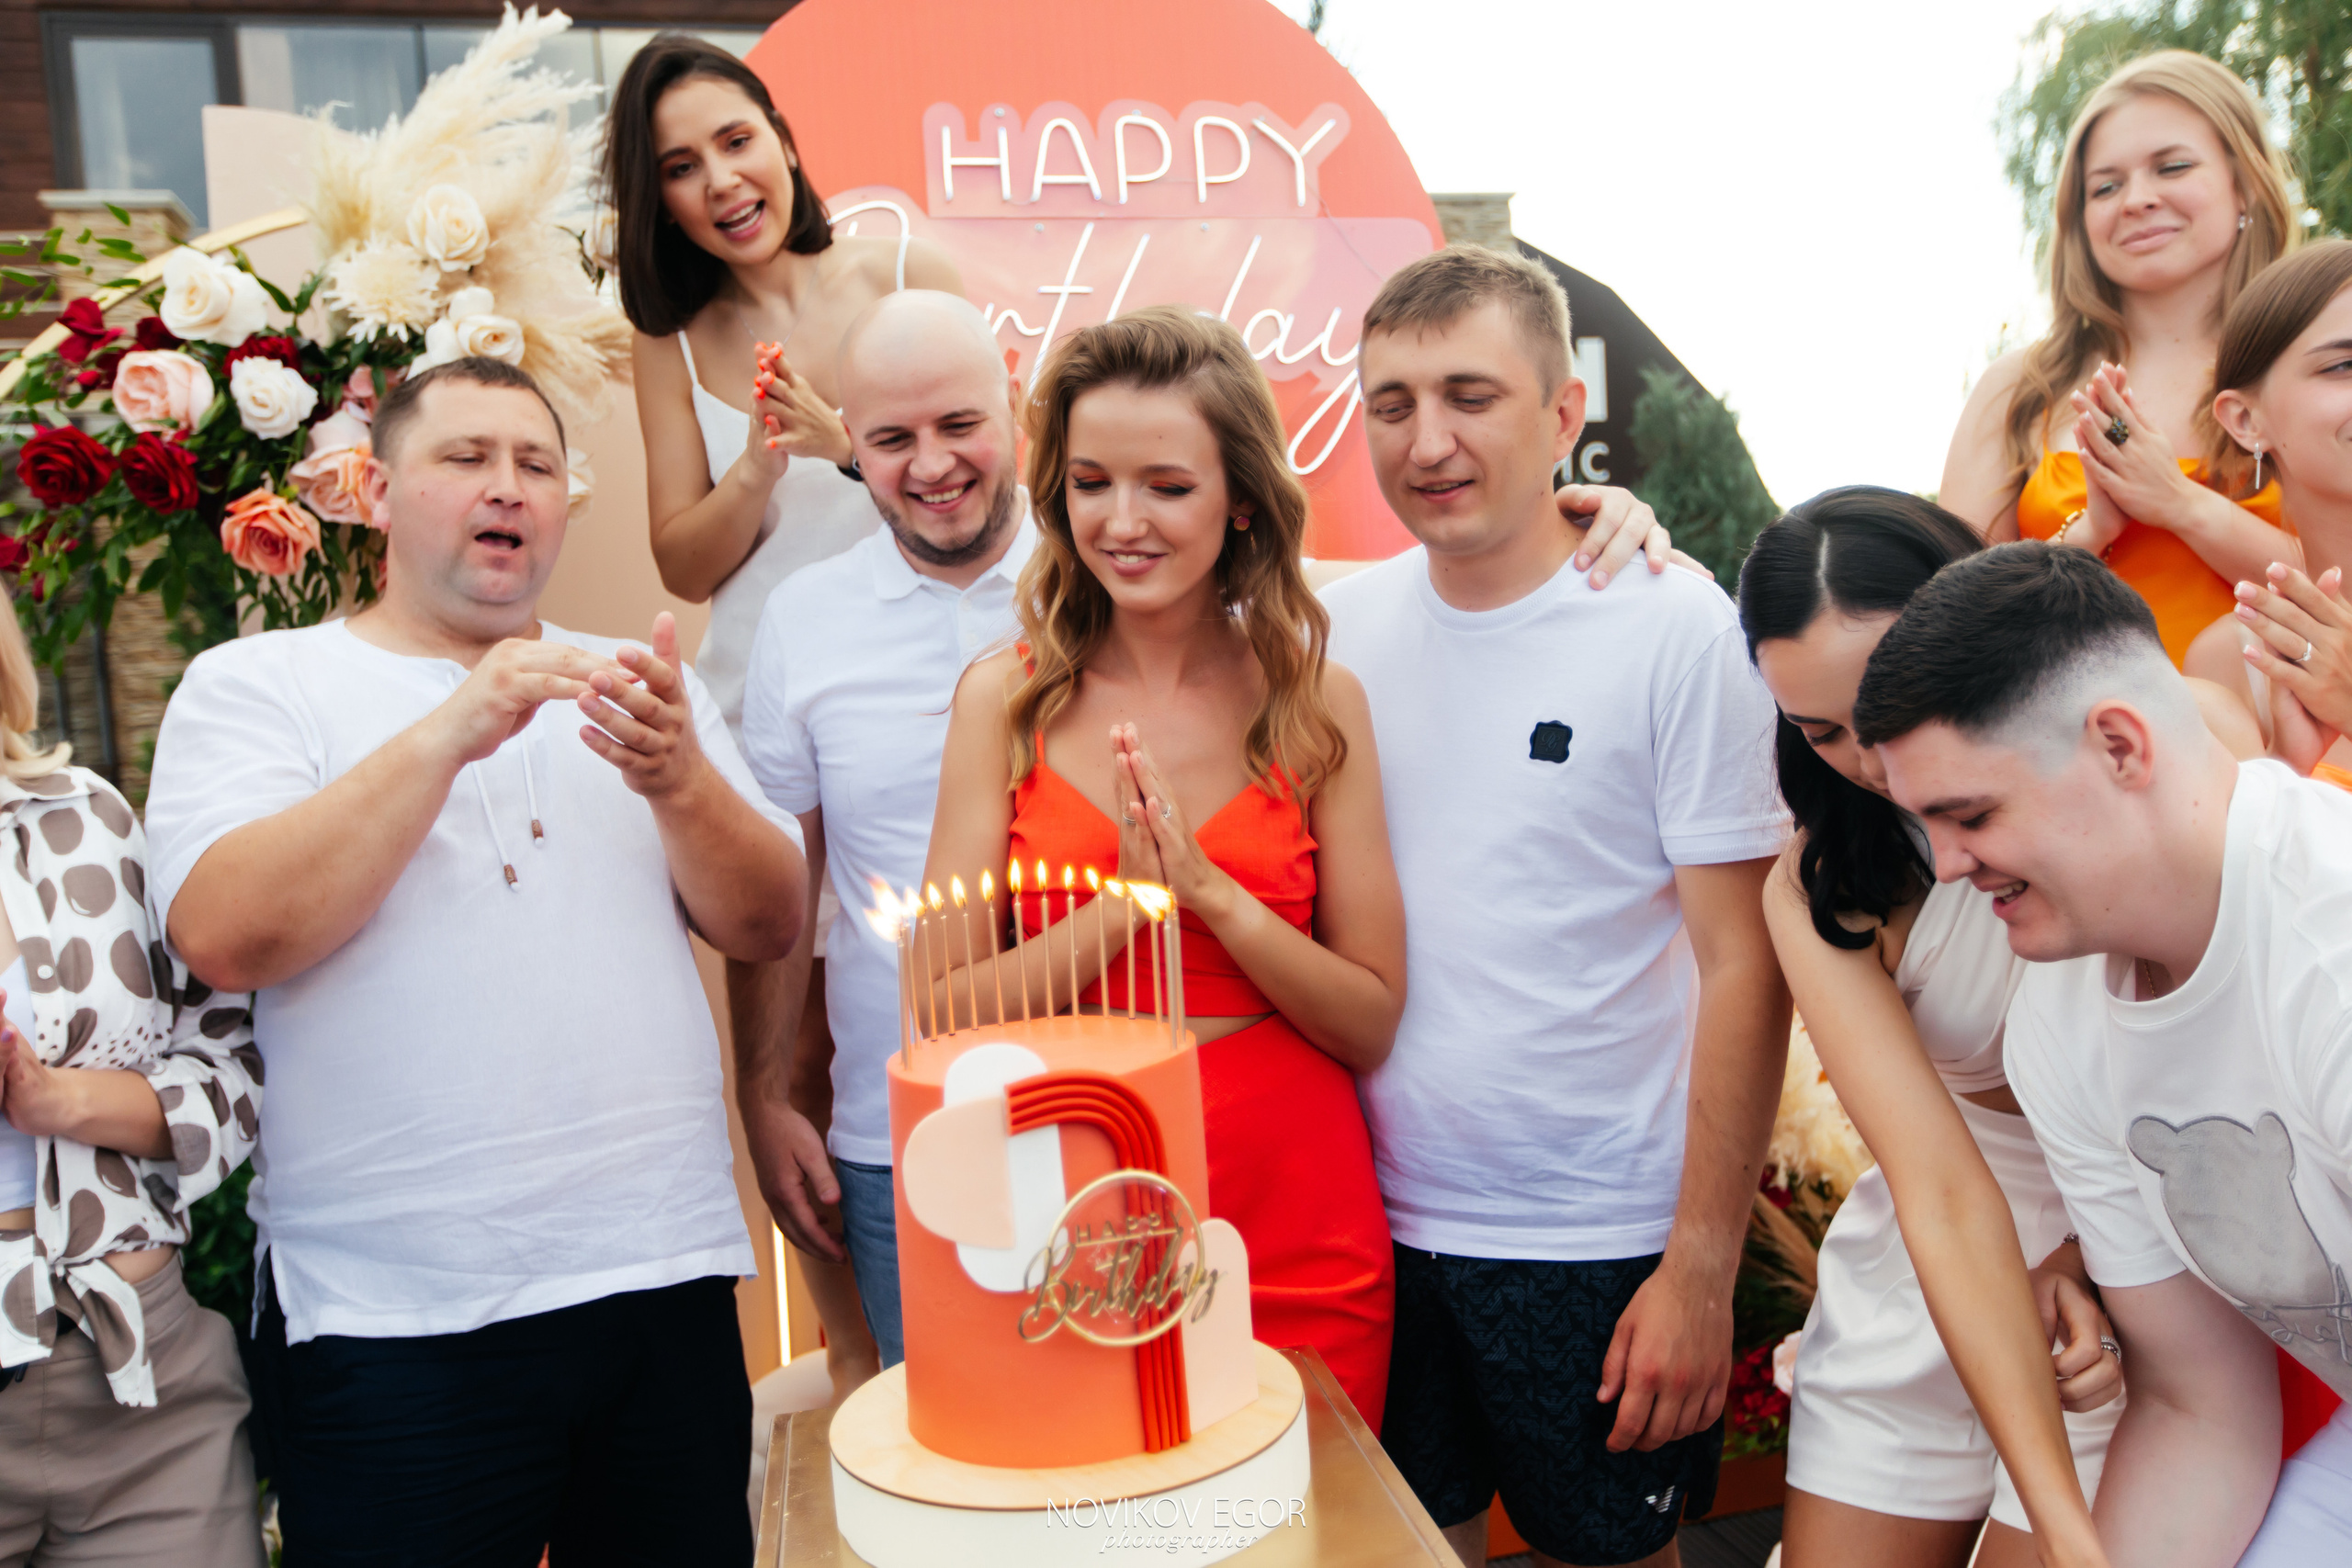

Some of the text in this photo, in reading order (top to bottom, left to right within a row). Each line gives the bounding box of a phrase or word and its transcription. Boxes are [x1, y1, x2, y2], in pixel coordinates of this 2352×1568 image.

[942, 116, 1337, 207] HAPPY
[1076, 1209, 1183, 1244] HAPPY
[1018, 1227, 1227, 1343] Birthday
